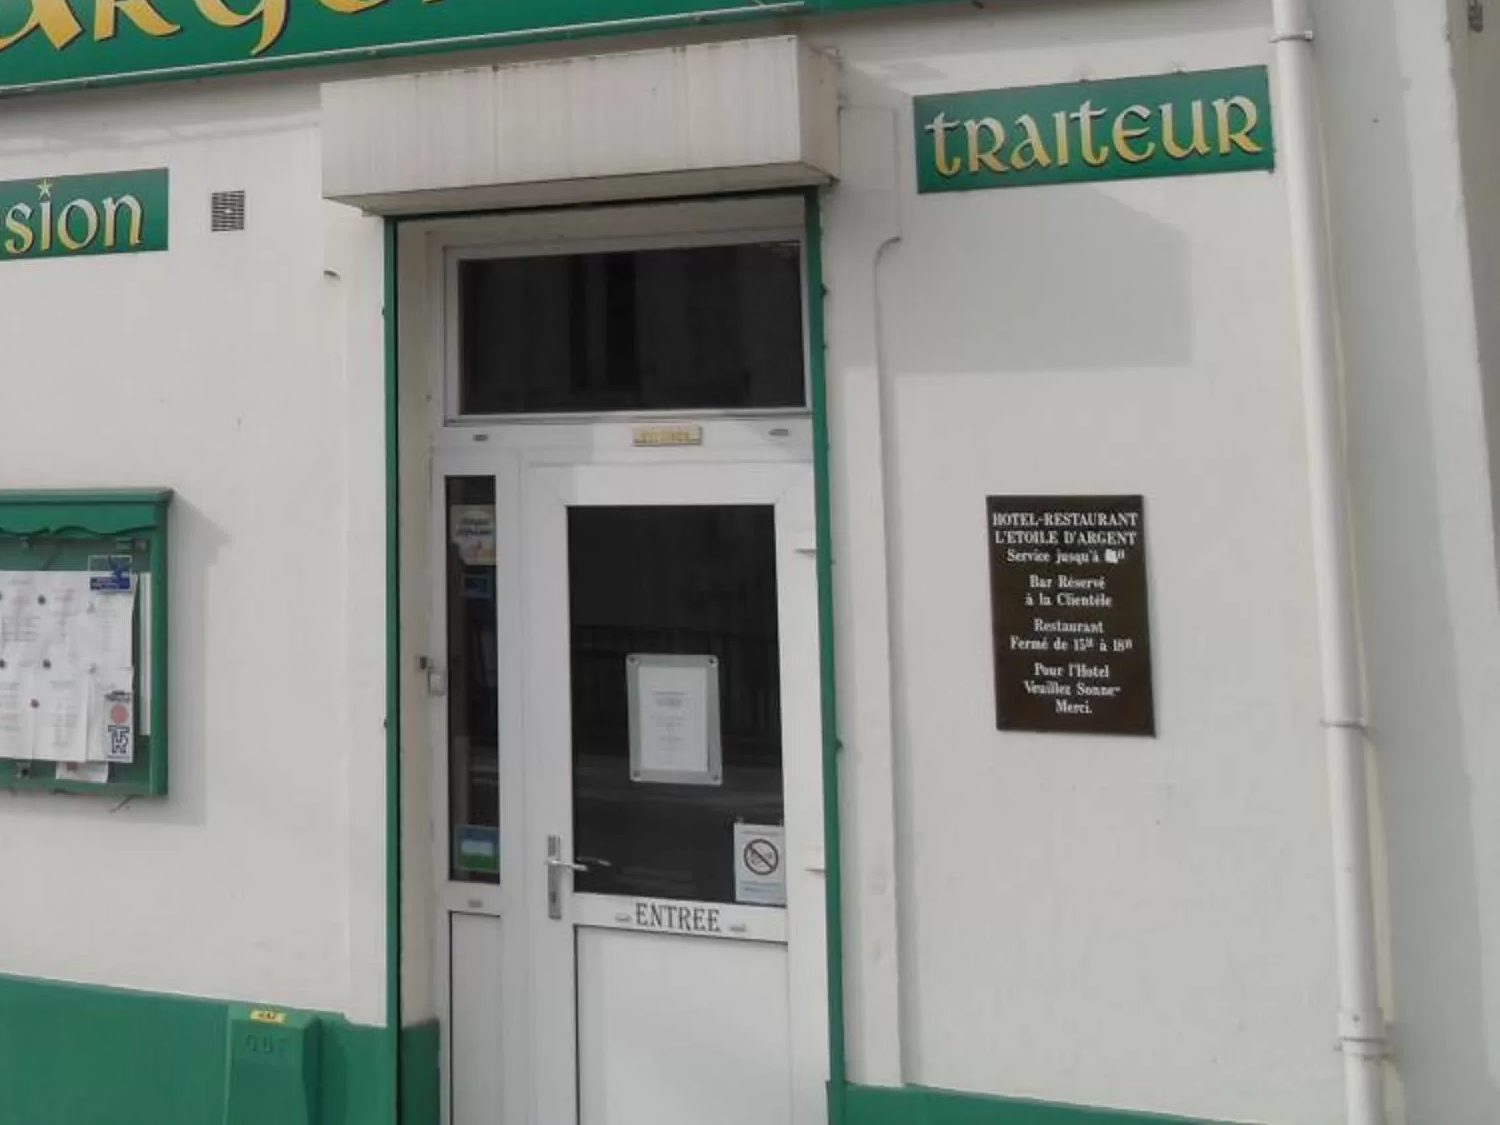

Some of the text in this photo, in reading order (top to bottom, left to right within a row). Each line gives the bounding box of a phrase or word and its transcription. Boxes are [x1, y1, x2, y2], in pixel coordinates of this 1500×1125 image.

[993, 512, 1139, 526] HOTEL-RESTAURANT
[995, 530, 1137, 546] L'ETOILE D'ARGENT
[1007, 548, 1051, 563] Service
[1055, 549, 1100, 565] jusqu'à
[1029, 574, 1106, 590] Bar Réservé
[1025, 593, 1035, 607] à
[1039, 593, 1052, 607] la
[1033, 618, 1105, 634] Restaurant
[1010, 635, 1049, 651] Fermé
[1053, 636, 1069, 652] de
[1099, 638, 1108, 653] à
[1034, 662, 1065, 677] Pour
[1023, 679, 1073, 697] Veuillez
[1055, 698, 1093, 715] Merci.
[634, 901, 722, 933] ENTREE
